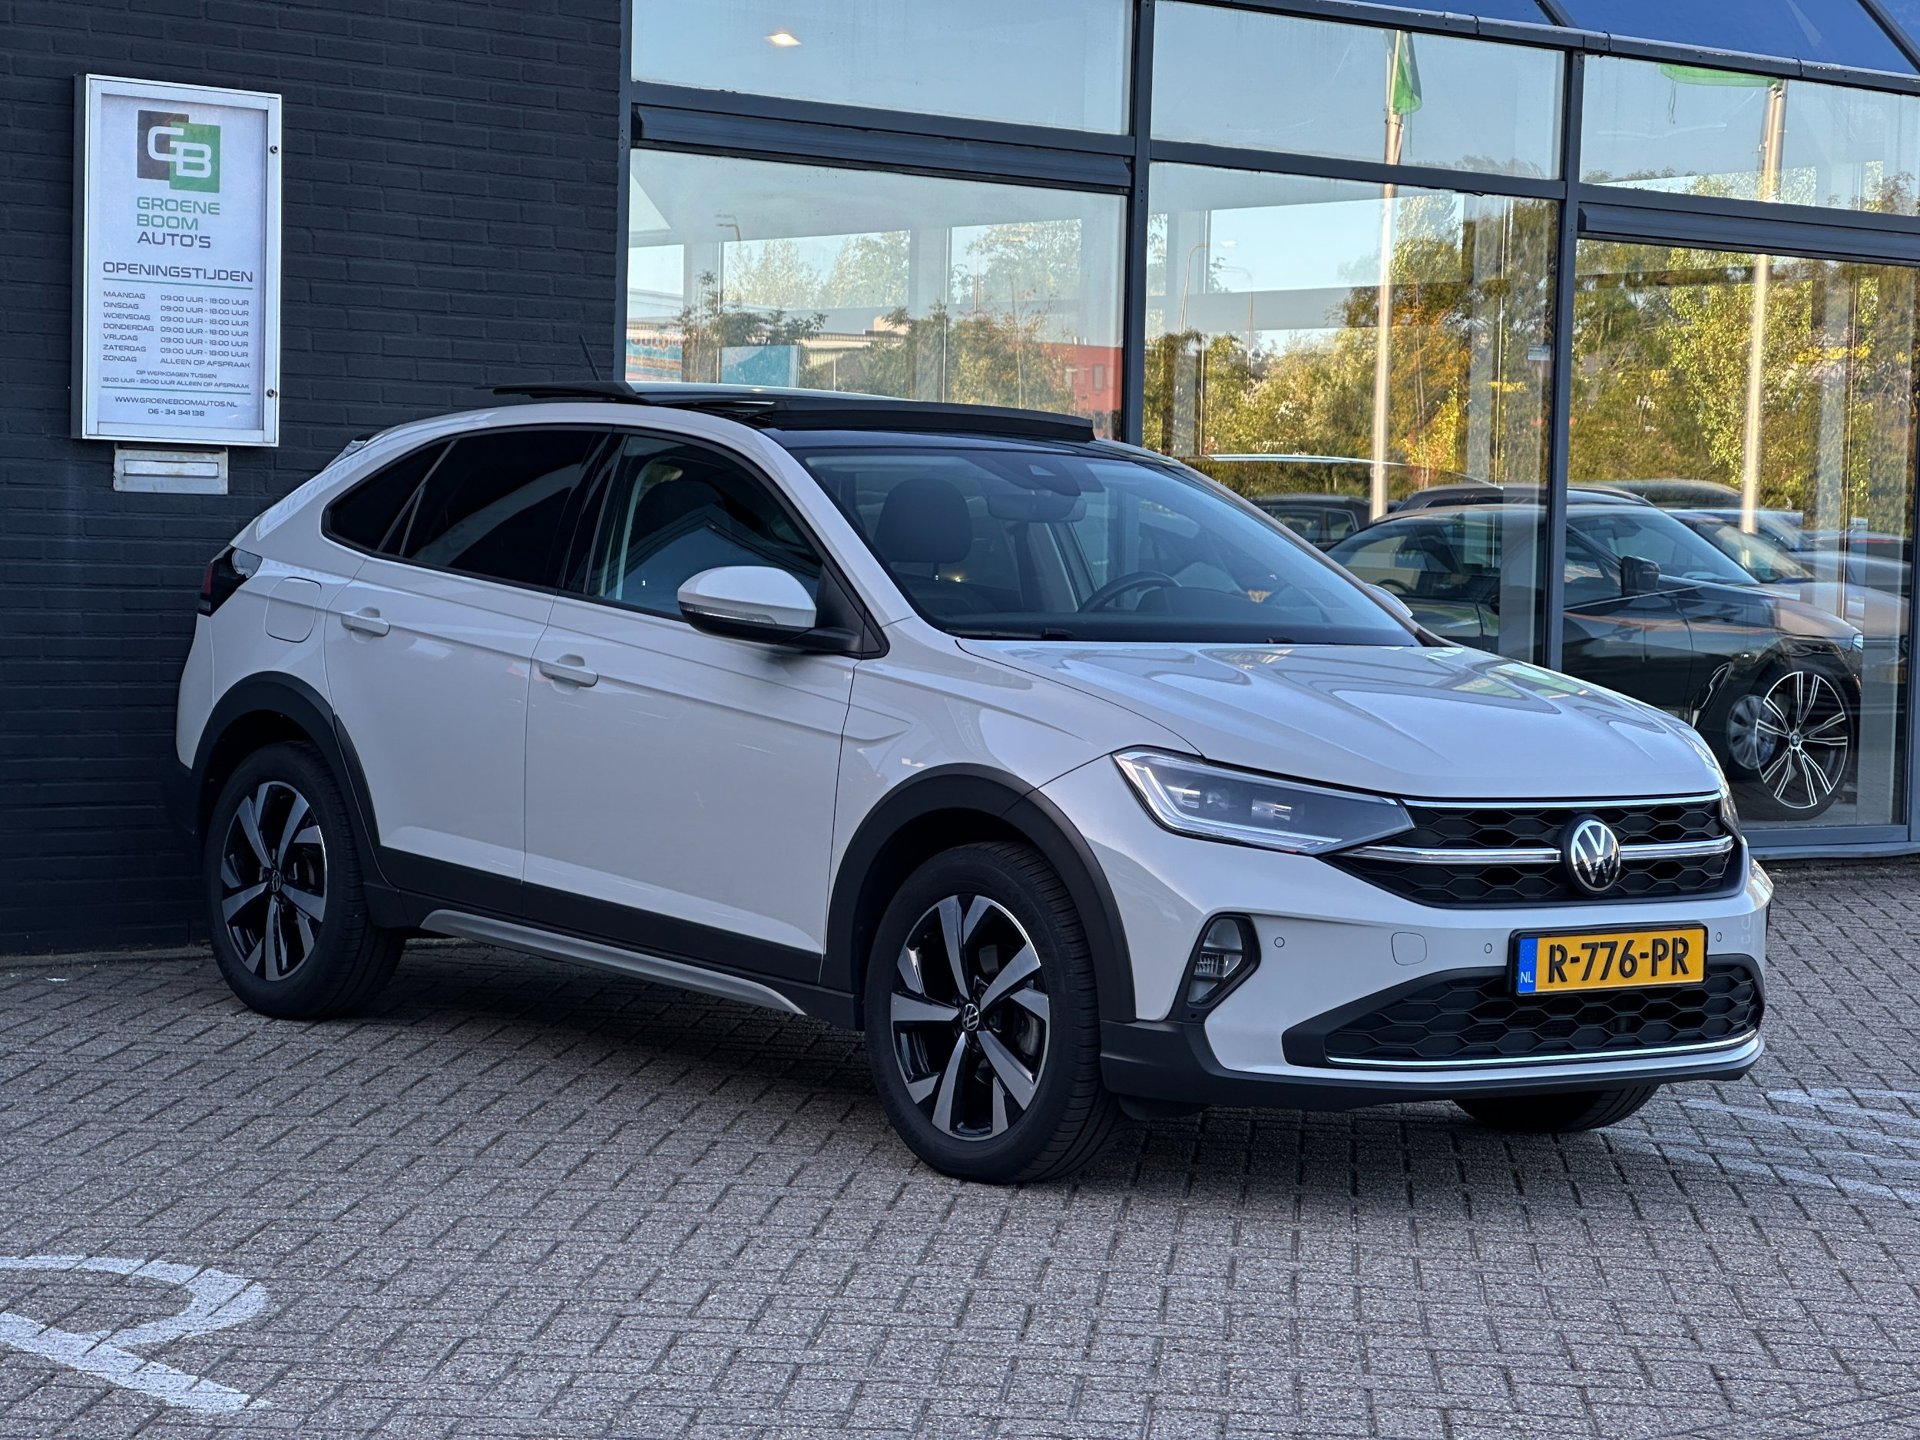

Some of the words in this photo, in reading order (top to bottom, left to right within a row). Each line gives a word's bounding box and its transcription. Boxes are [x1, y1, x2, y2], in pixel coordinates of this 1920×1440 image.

[136, 196, 220, 215] GROENE
[136, 213, 198, 230] BOOM
[136, 231, 211, 249] AUTO'S
[102, 261, 253, 283] OPENINGSTIJDEN
[103, 291, 146, 299] MAANDAG
[160, 294, 184, 302] 09:00
[103, 302, 139, 310] DINSDAG
[185, 306, 204, 314] UUR
[103, 312, 150, 320] WOENSDAG
[103, 322, 154, 332] DONDERDAG
[160, 326, 184, 334] 09:00
[209, 328, 229, 336] 18:00
[103, 333, 138, 341] VRIJDAG
[102, 344, 146, 352] ZATERDAG
[160, 347, 184, 355] 09:00
[185, 348, 204, 356] UUR
[102, 354, 137, 362] ZONDAG
[206, 360, 250, 368] AFSPRAAK
[1548, 937, 1690, 984] R-776-PR
[1520, 971, 1534, 984] NL
